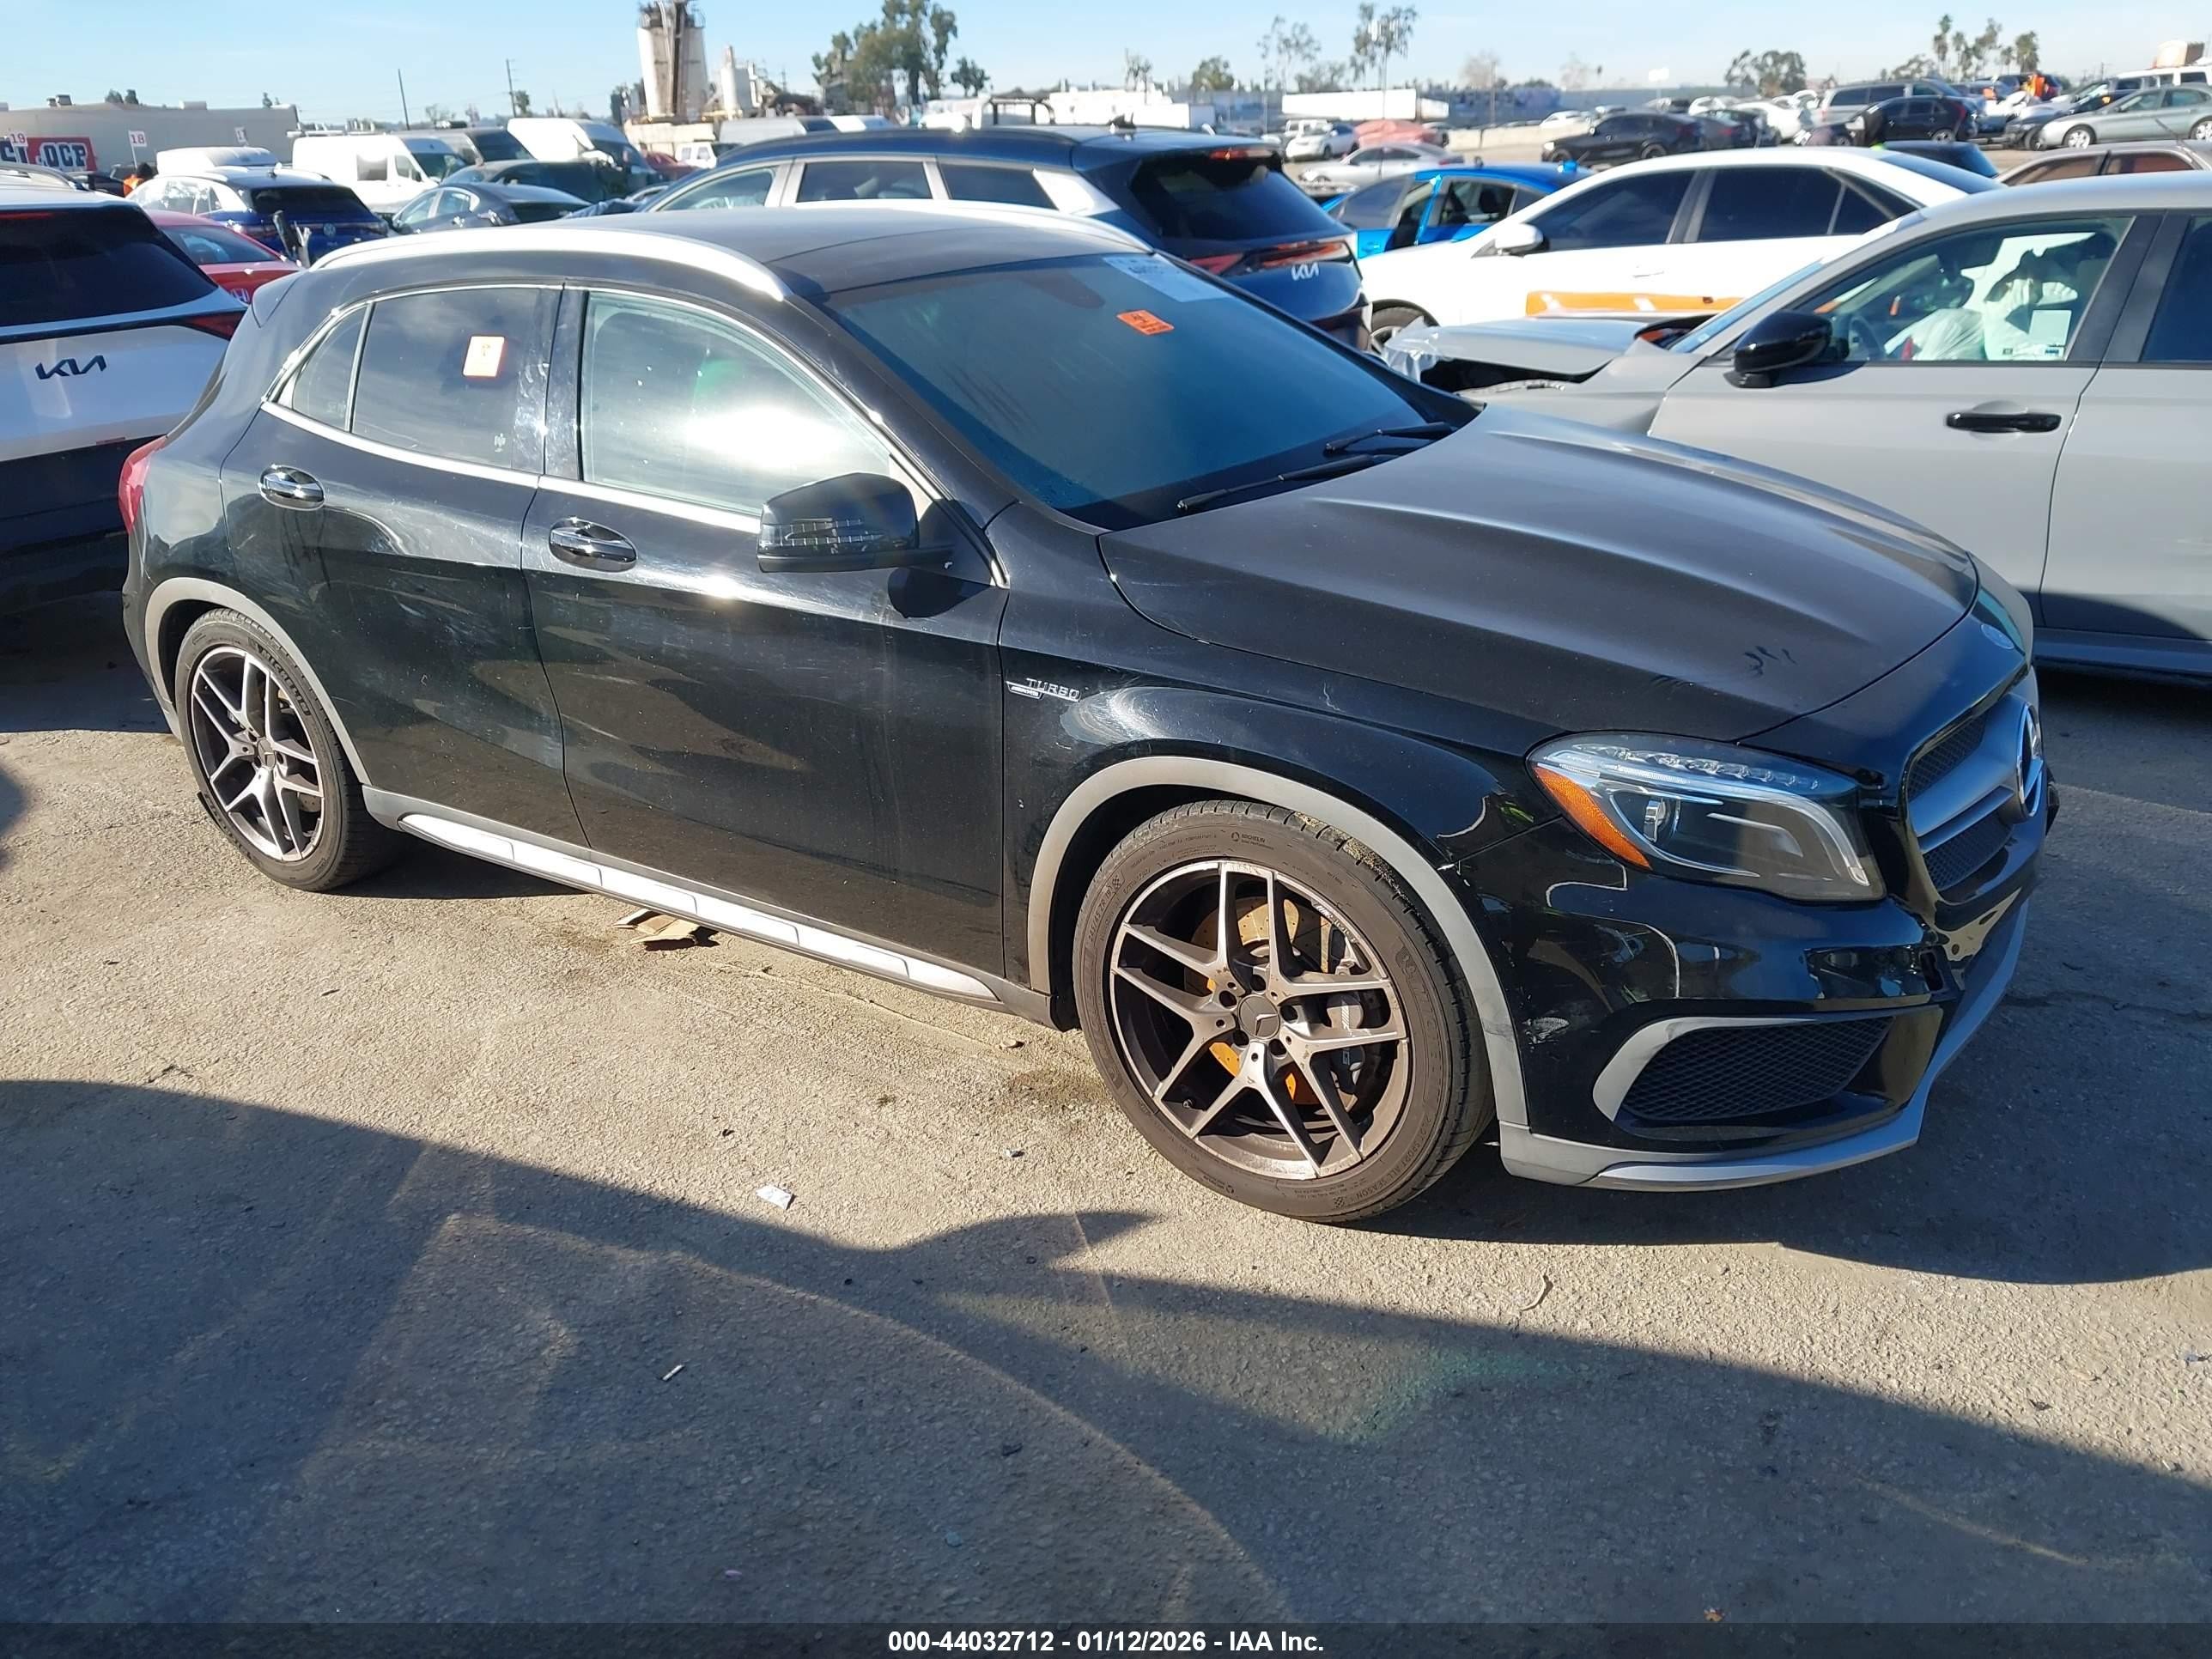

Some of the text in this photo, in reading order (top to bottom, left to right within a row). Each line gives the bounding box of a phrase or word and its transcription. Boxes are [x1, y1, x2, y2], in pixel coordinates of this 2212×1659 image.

[9, 132, 26, 143] 19
[130, 133, 145, 144] 18
[1291, 262, 1320, 281] KIA
[34, 355, 107, 380] KIA
[1026, 677, 1081, 701] TURBO
[1355, 1176, 1389, 1200] SEASON
